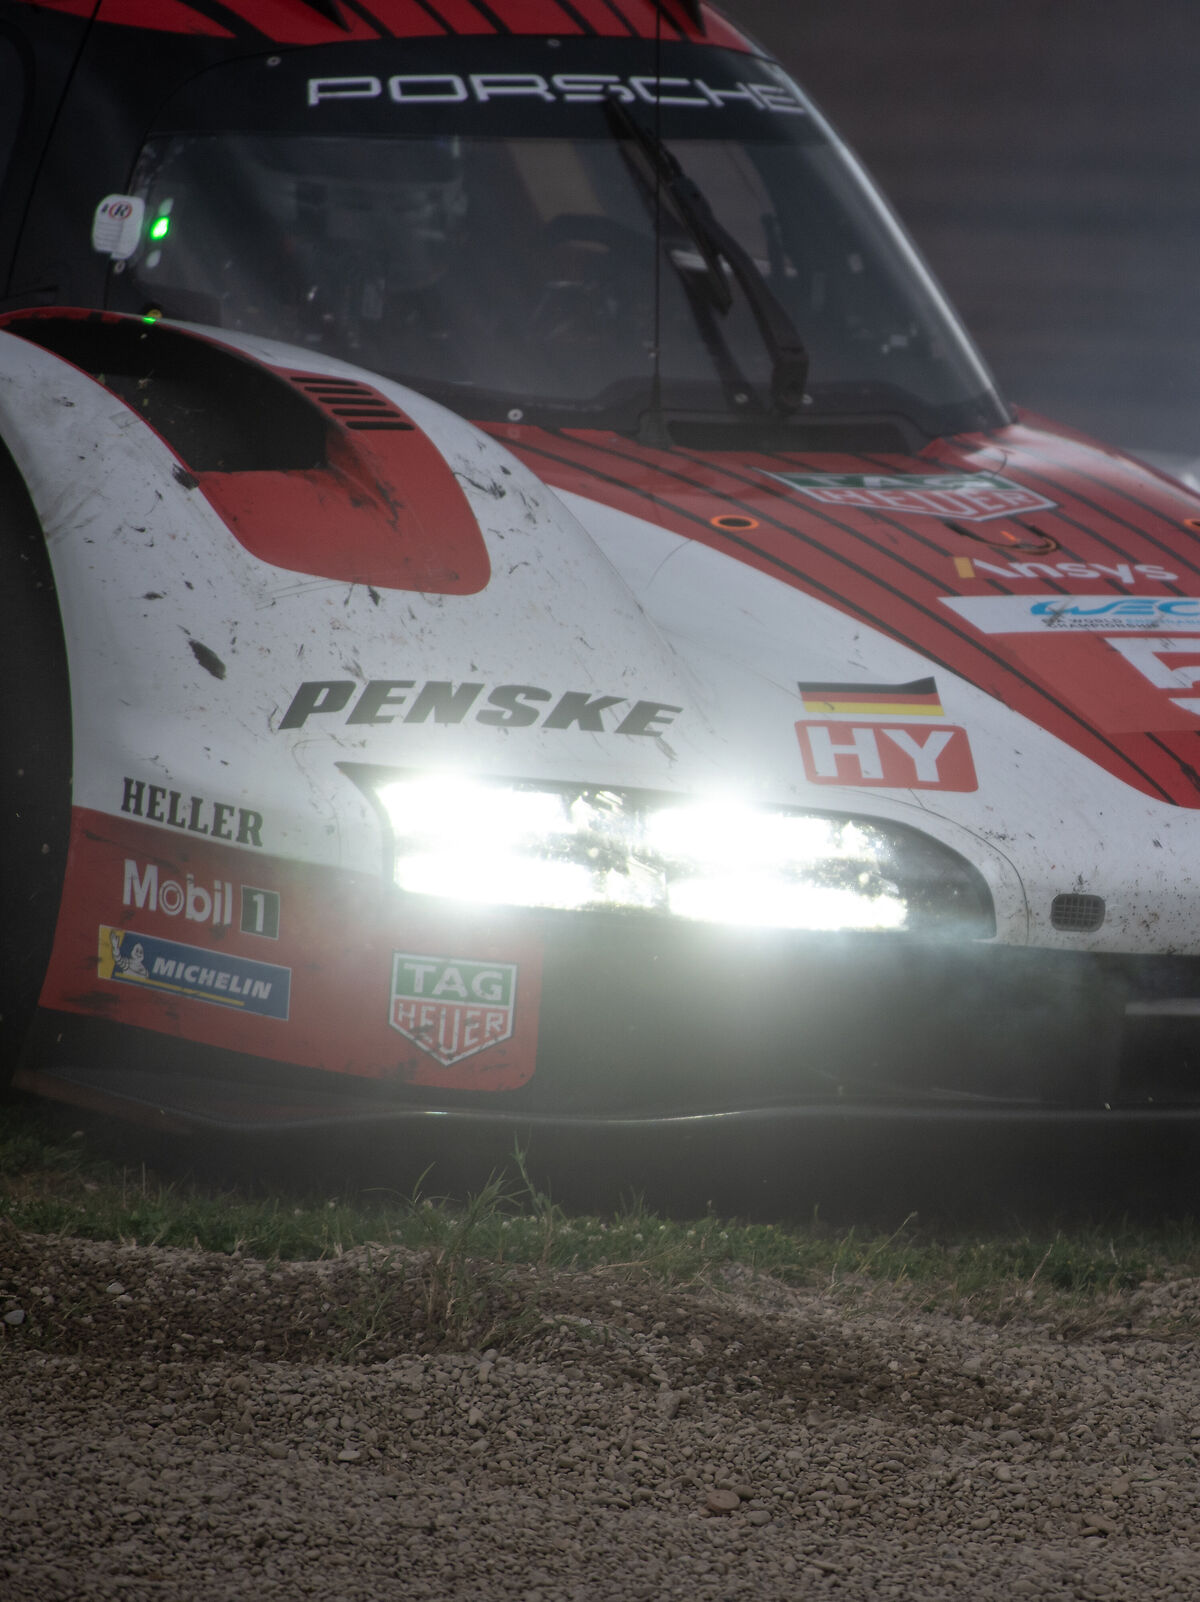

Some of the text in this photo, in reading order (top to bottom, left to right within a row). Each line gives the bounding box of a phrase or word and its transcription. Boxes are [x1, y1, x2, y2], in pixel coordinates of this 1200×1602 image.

[308, 73, 804, 113] PORSCHE
[818, 490, 1035, 516] HEUER
[1029, 598, 1200, 617] WEC
[277, 679, 683, 738] PENSKE
[805, 725, 956, 783] HY
[120, 776, 264, 848] HELLER
[122, 858, 266, 933] Mobil 1
[151, 956, 273, 1000] MICHELIN
[403, 962, 504, 1001] TAG
[398, 1002, 504, 1055] HEUER
